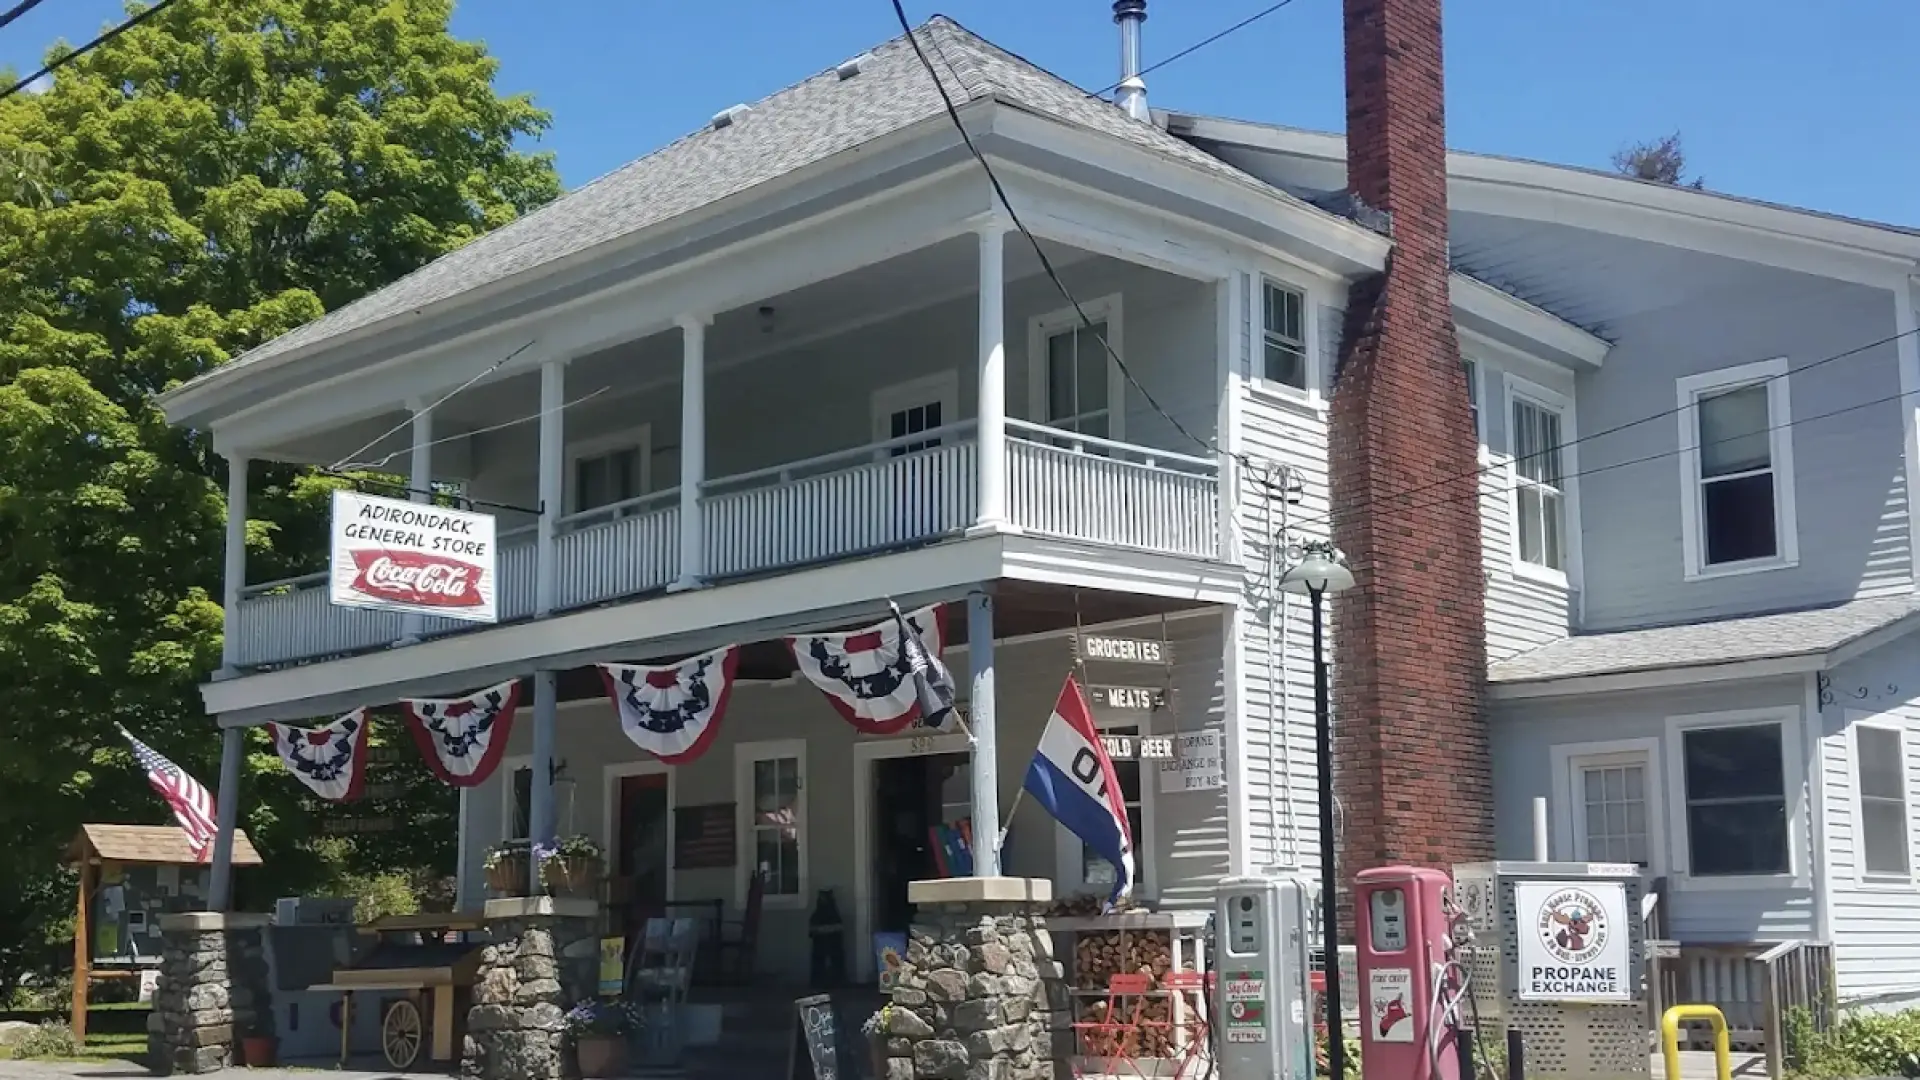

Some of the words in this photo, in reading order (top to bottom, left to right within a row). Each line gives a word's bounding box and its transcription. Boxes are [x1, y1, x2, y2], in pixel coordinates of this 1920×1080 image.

[359, 504, 473, 534] ADIRONDACK
[345, 523, 425, 547] GENERAL
[432, 536, 486, 556] STORE
[1087, 638, 1160, 661] GROCERIES
[1108, 688, 1150, 709] MEATS
[1140, 738, 1173, 758] BEER
[1532, 967, 1617, 980] PROPANE
[1532, 981, 1617, 993] EXCHANGE
